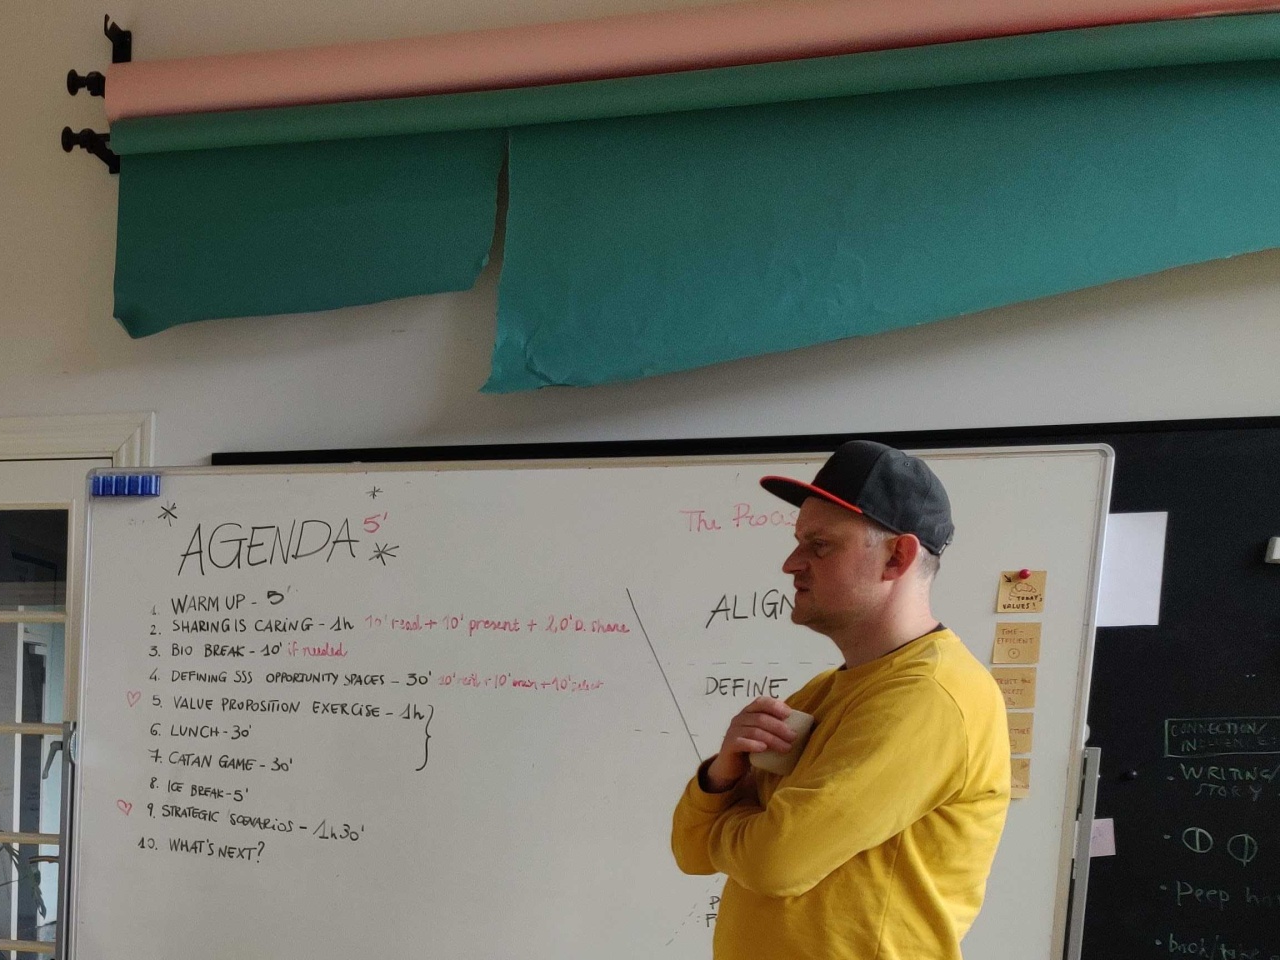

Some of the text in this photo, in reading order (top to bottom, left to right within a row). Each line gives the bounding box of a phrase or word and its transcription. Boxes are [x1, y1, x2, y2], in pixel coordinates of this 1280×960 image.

[679, 509, 722, 532] The
[178, 518, 360, 576] AGENDA
[171, 594, 219, 615] WARM
[225, 594, 246, 611] UP
[172, 618, 230, 634] SHARING
[234, 619, 247, 633] IS
[469, 617, 521, 637] present
[171, 643, 193, 657] BIO
[204, 643, 246, 658] BREAK
[287, 641, 299, 658] if
[302, 642, 348, 657] needed
[171, 670, 228, 684] DEFINING
[233, 670, 254, 684] SSS
[265, 672, 339, 686] OPPORTUNITY
[343, 673, 386, 687] SPACES
[704, 675, 789, 699] DEFINE
[173, 696, 213, 711] VALUE
[221, 698, 301, 714] PROPOSITION
[168, 751, 212, 768] CATAN
[218, 755, 257, 771] GAME
[167, 779, 184, 793] ICE
[161, 804, 220, 823] STRATEGIC
[168, 837, 215, 856] WHAT'S
[217, 840, 266, 863] NEXT?
